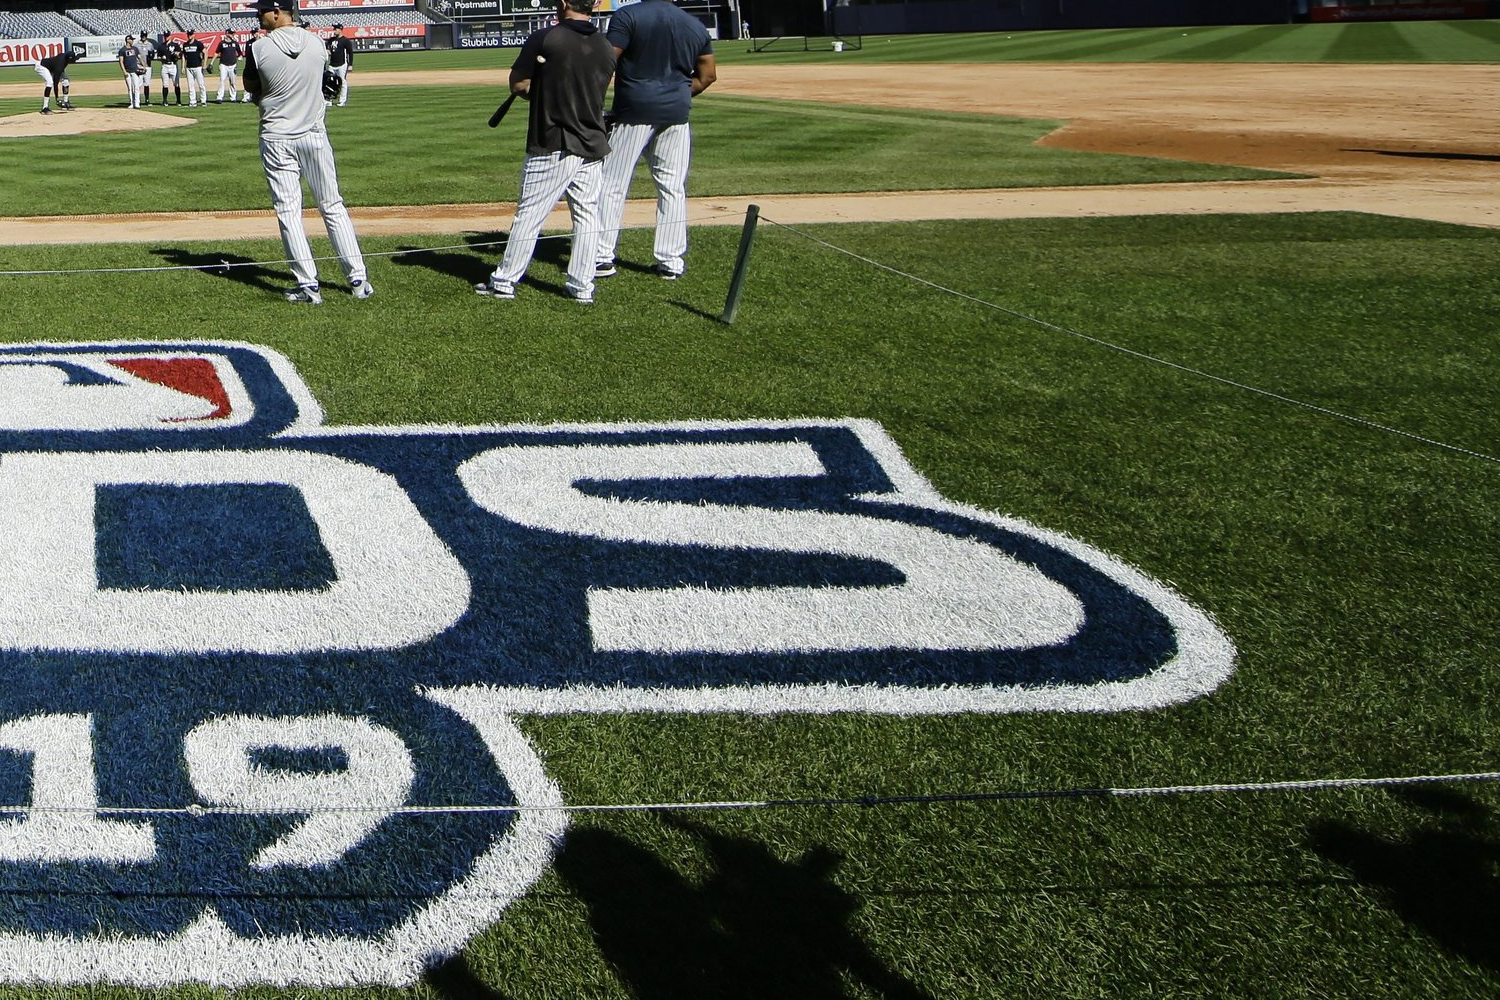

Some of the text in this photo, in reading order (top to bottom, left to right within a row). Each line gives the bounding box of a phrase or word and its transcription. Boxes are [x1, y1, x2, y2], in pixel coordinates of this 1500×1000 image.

[455, 1, 497, 9] Postmates
[461, 37, 527, 47] StubHub StubH
